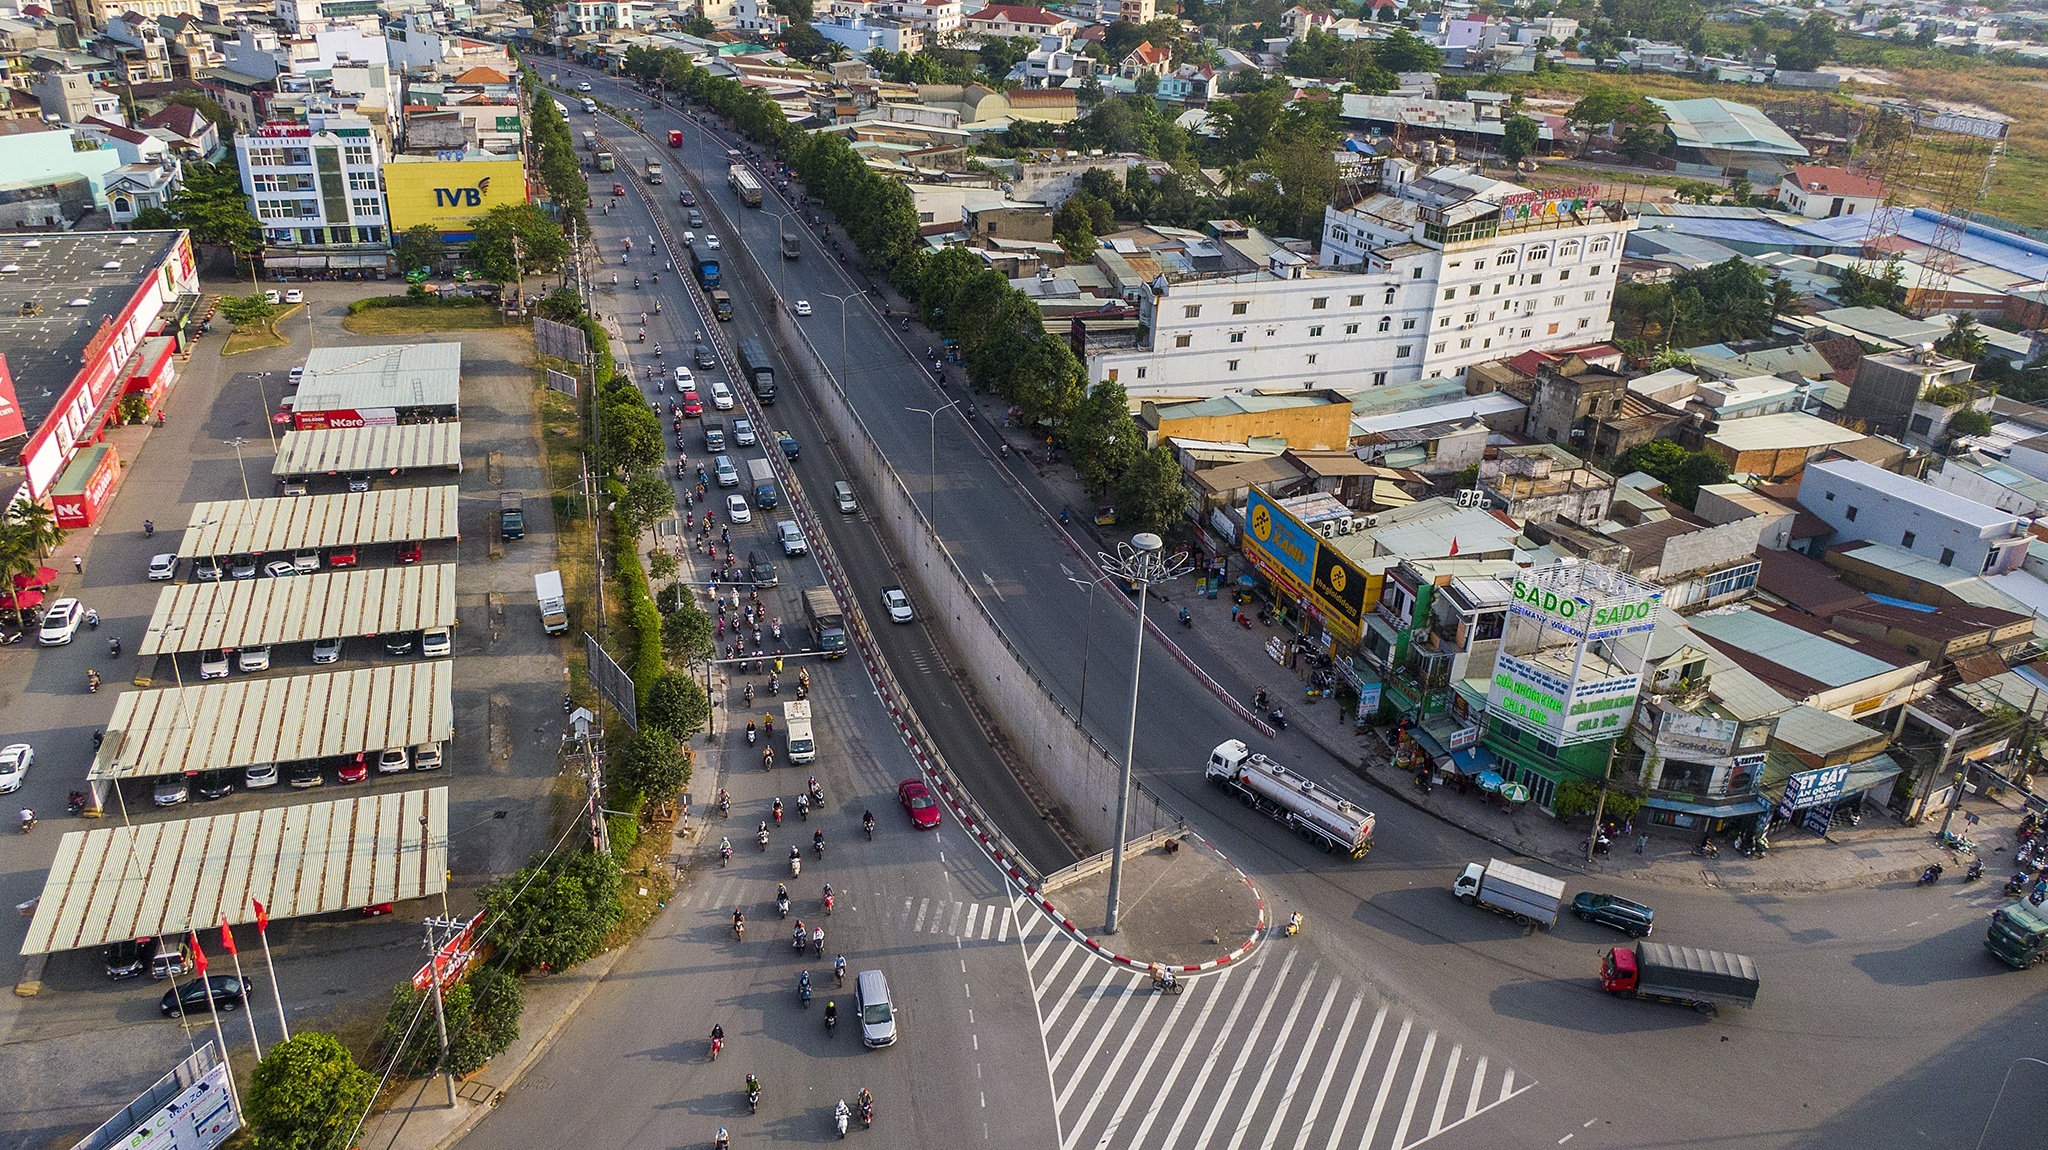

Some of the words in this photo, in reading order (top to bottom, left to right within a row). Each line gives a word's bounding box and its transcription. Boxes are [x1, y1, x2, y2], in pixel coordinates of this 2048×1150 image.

[1934, 117, 1951, 130] 094
[1953, 119, 1972, 133] 858
[1973, 123, 1986, 135] 66
[1987, 125, 2000, 137] 22
[433, 187, 481, 207] IVB
[1503, 197, 1597, 221] KARAOKE
[331, 418, 363, 428] NKare
[56, 503, 83, 517] NK
[1272, 529, 1307, 567] XANH
[1316, 577, 1357, 617] thegioididong
[1513, 581, 1575, 619] SADO
[1509, 603, 1547, 625] GERMANY
[1550, 619, 1584, 639] WINDOW
[1594, 601, 1650, 626] SADO
[1588, 628, 1623, 640] GERMANY
[1513, 681, 1540, 704] NHÔM
[1540, 693, 1564, 714] KÍNH
[1796, 773, 1817, 790] ÉT
[1818, 767, 1848, 787] SẮT
[1813, 782, 1836, 795] QUỐC
[156, 1116, 166, 1128] C
